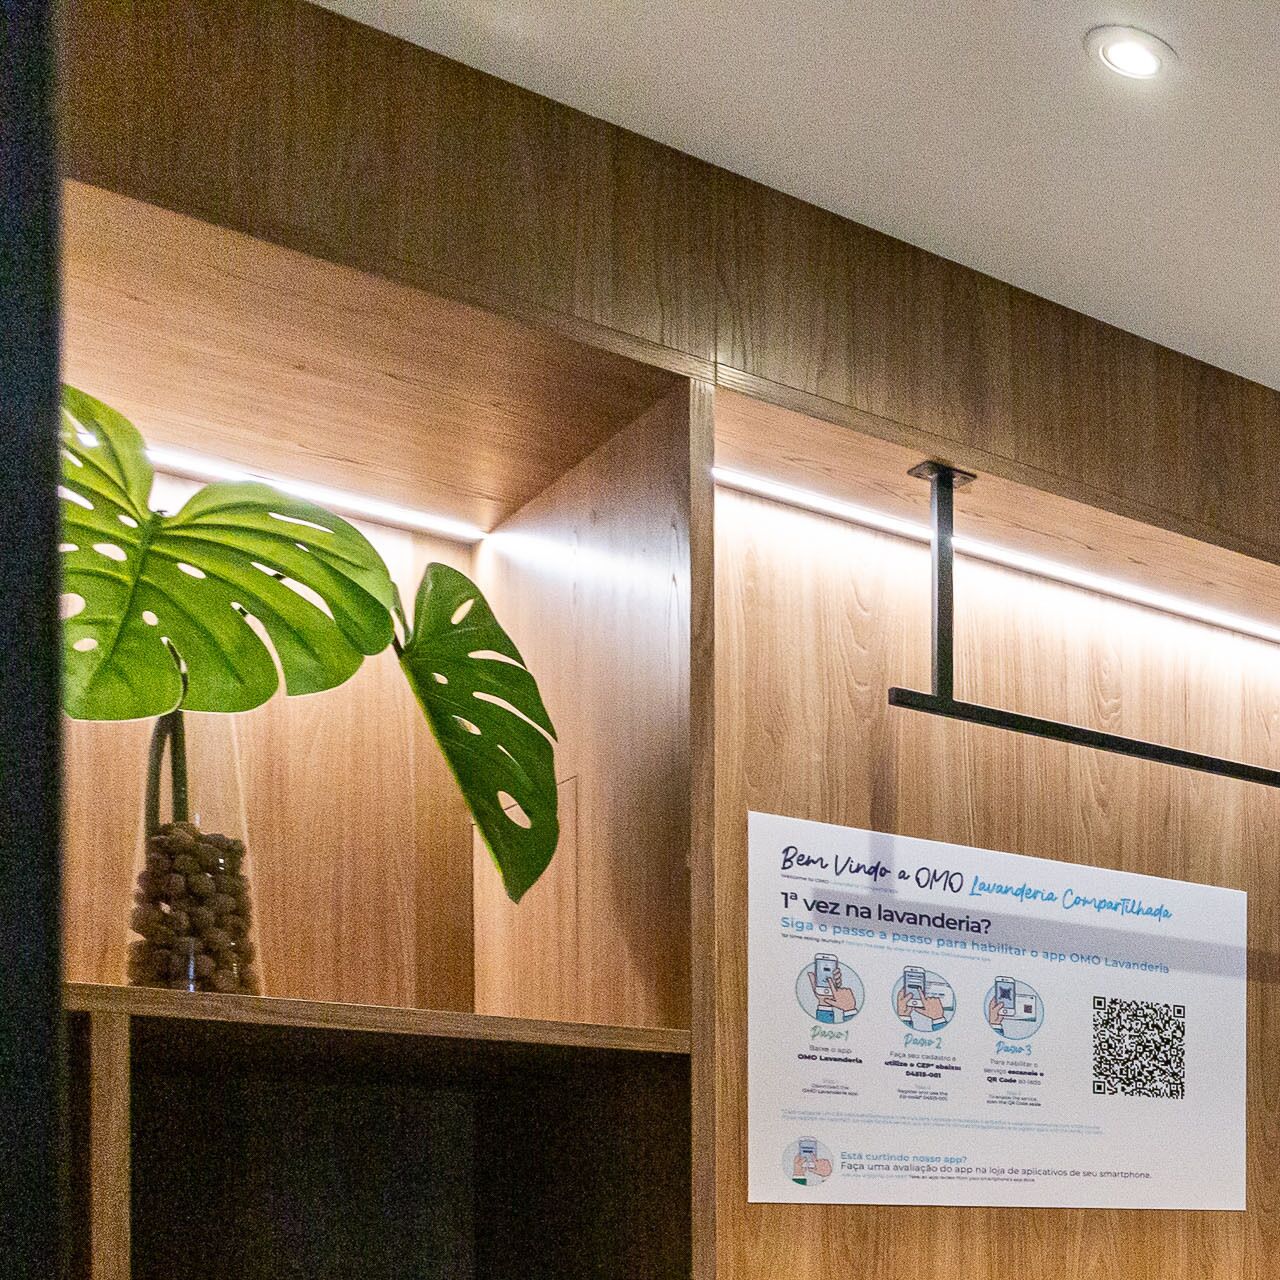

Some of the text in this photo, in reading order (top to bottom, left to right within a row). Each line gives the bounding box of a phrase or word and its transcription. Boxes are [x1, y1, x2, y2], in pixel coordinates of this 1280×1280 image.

[780, 845, 829, 870] Bem
[834, 855, 891, 881] Vindo
[897, 869, 911, 880] a
[915, 867, 964, 893] OMO
[969, 875, 1058, 902] Lavanderia
[1062, 888, 1174, 922] Compartilhada
[780, 892, 991, 934] 1ª vez na lavanderia?
[781, 917, 814, 932] Siga
[819, 923, 828, 932] o
[832, 925, 875, 939] passo
[879, 930, 888, 940] a
[892, 931, 932, 945] passo
[937, 937, 967, 951] para
[971, 940, 1027, 957] habilitar
[1031, 950, 1039, 958] o
[1042, 951, 1066, 964] app
[1070, 952, 1101, 965] OMO
[1105, 957, 1170, 974] Lavanderia
[904, 1033, 942, 1049] Passo 2
[996, 1040, 1032, 1056] Passo 3
[820, 1055, 863, 1064] Lavanderia
[841, 1151, 968, 1165] Está curtindo nosso app?
[840, 1162, 865, 1172] Faça
[867, 1163, 890, 1171] uma
[892, 1163, 938, 1174] avaliação
[940, 1165, 953, 1173] do
[955, 1166, 973, 1175] app
[989, 1166, 1005, 1176] loja
[1007, 1166, 1020, 1174] de
[1021, 1167, 1068, 1177] aplicativos
[1070, 1168, 1080, 1177] de
